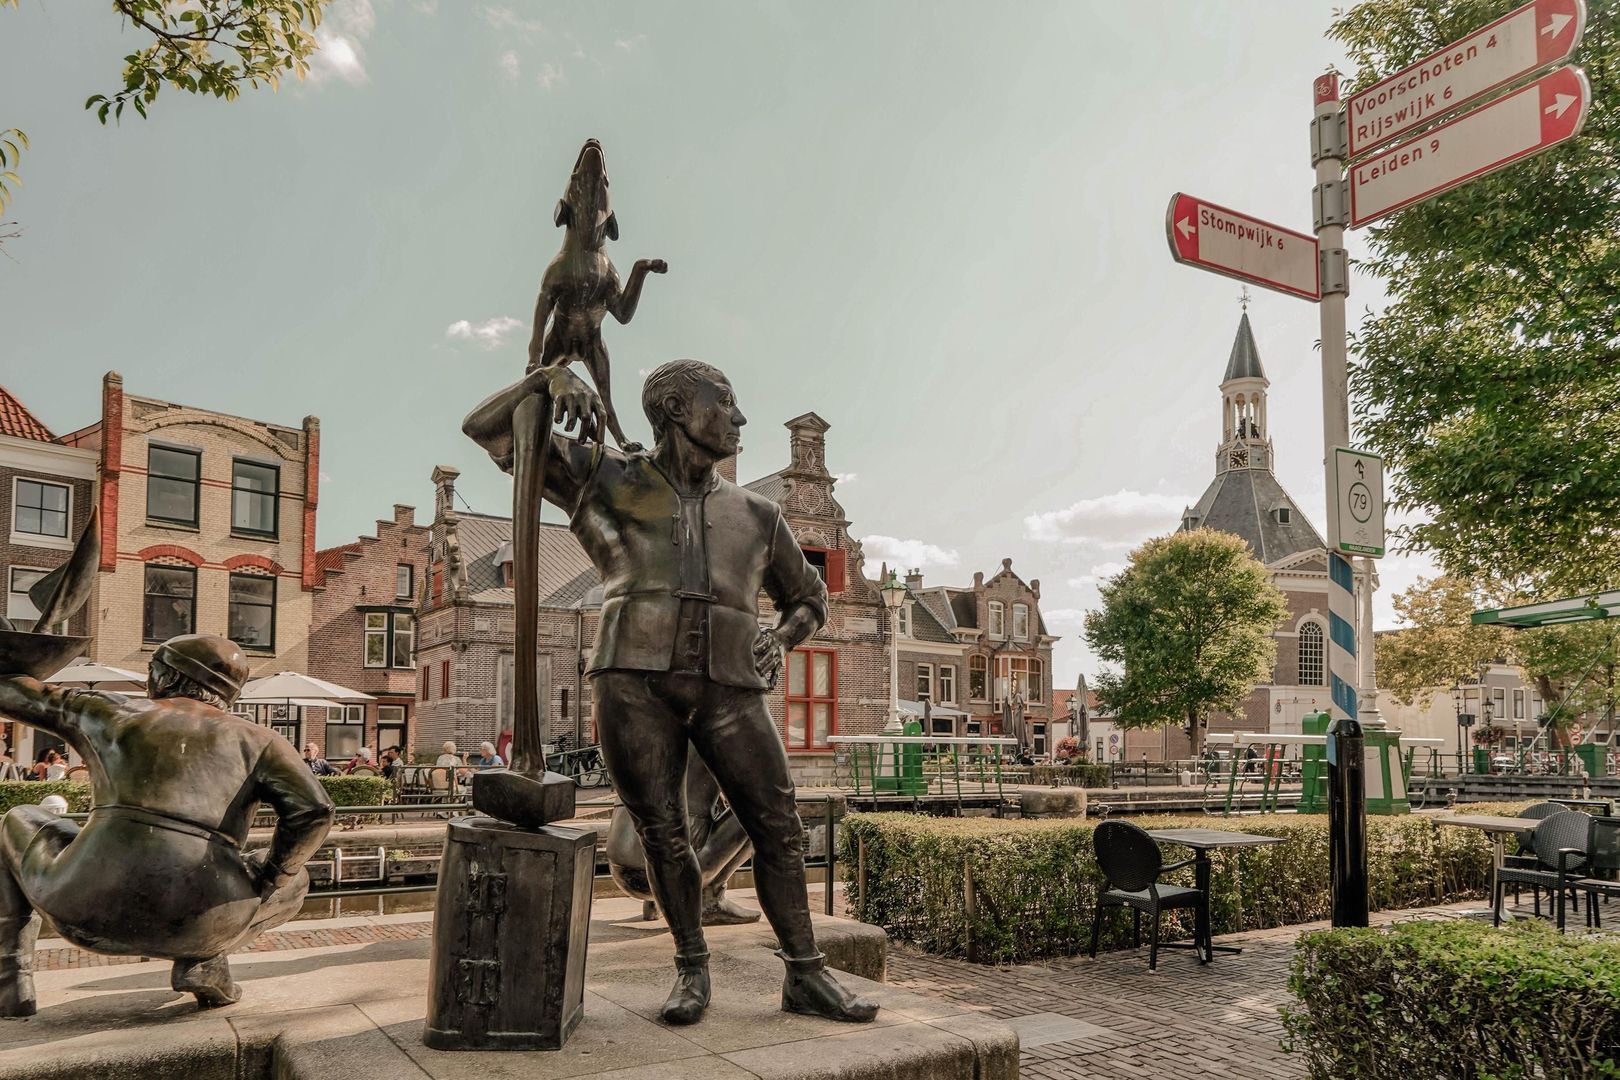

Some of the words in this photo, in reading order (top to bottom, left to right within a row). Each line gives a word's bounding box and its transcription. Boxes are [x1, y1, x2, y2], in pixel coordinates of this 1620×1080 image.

[1355, 45, 1477, 116] Voorschoten
[1486, 34, 1497, 49] 4
[1357, 93, 1436, 142] Rijswijk
[1443, 84, 1453, 100] 6
[1359, 147, 1423, 186] Leiden
[1430, 139, 1440, 153] 9
[1201, 209, 1273, 248] Stompwijk
[1277, 238, 1284, 250] 6
[1353, 493, 1367, 510] 79
